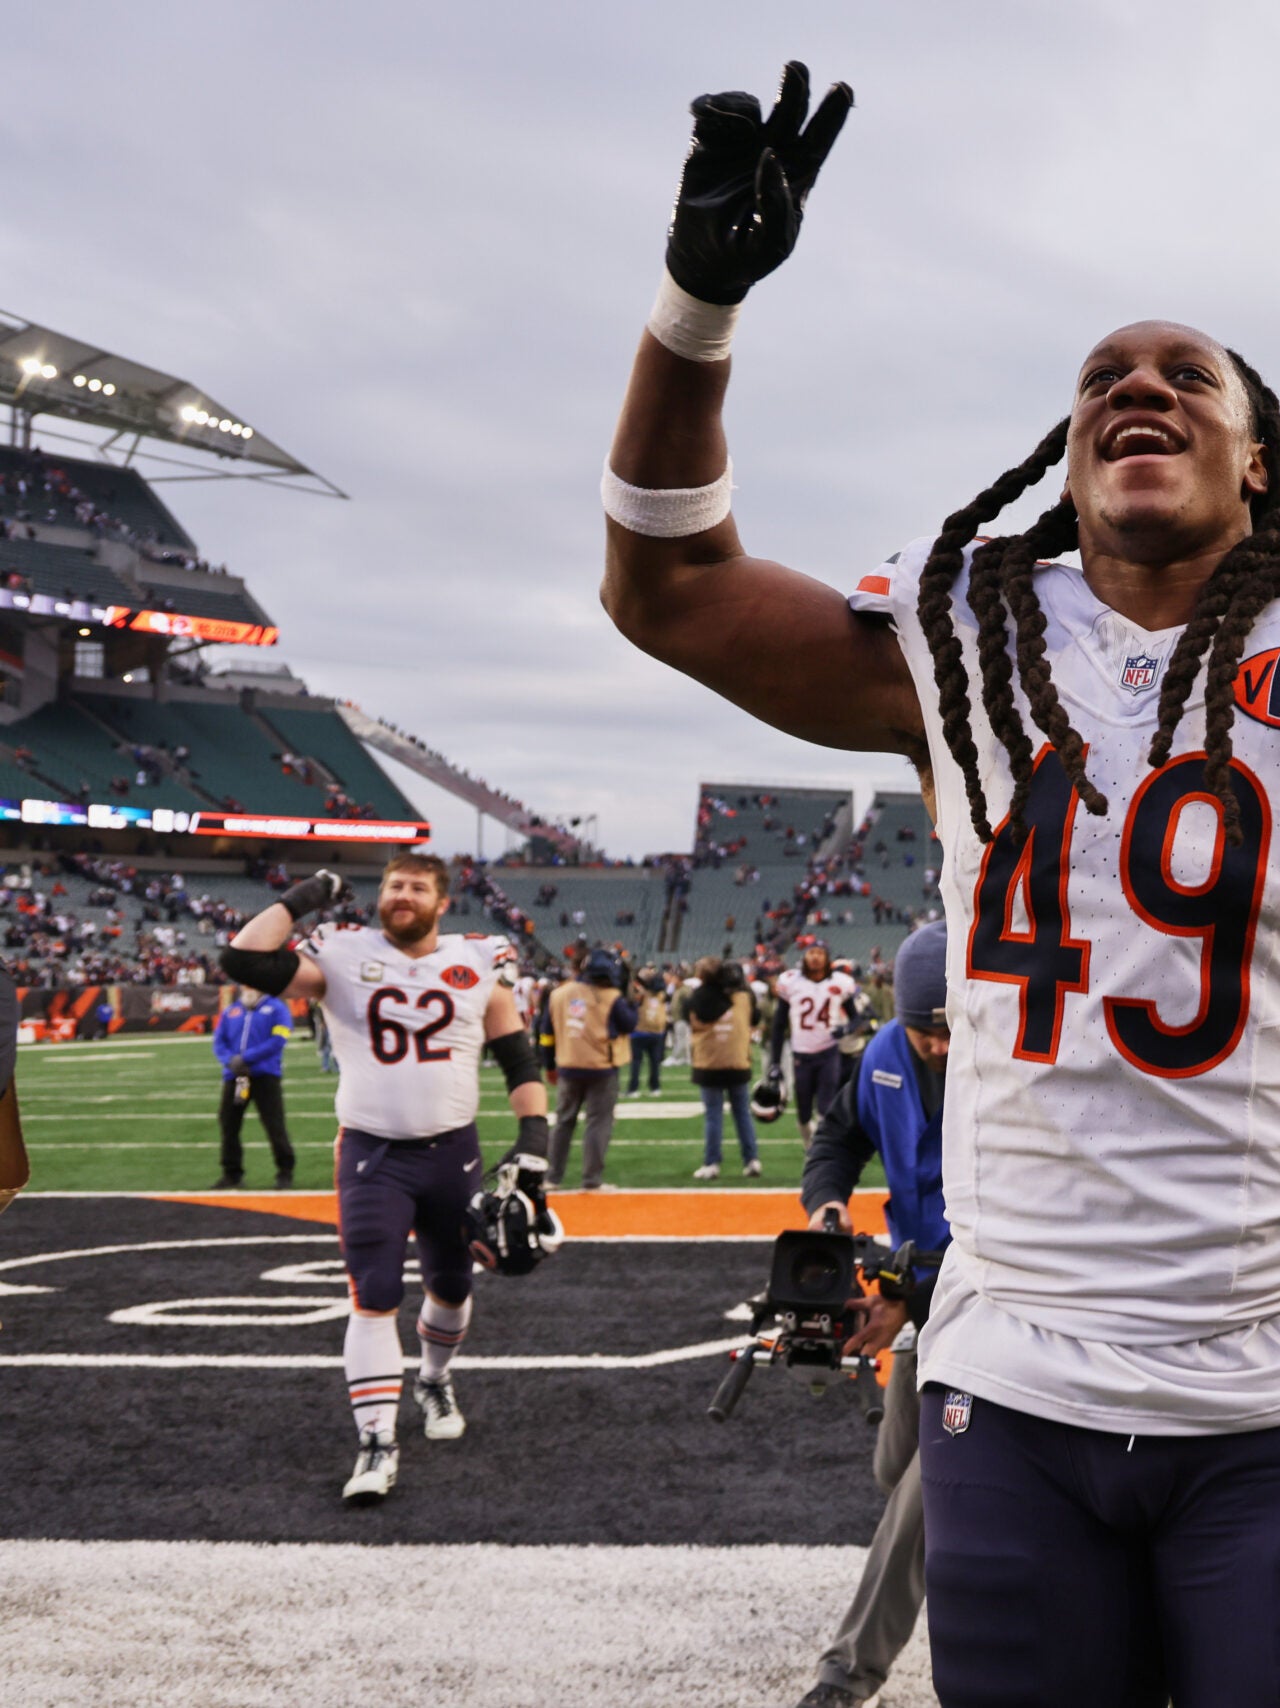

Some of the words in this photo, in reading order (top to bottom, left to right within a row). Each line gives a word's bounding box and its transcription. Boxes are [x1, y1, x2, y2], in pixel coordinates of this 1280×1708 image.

[1124, 668, 1151, 686] NFL
[966, 742, 1272, 1079] 49
[367, 986, 455, 1065] 62
[800, 996, 831, 1030] 24
[945, 1407, 965, 1426] NFL
